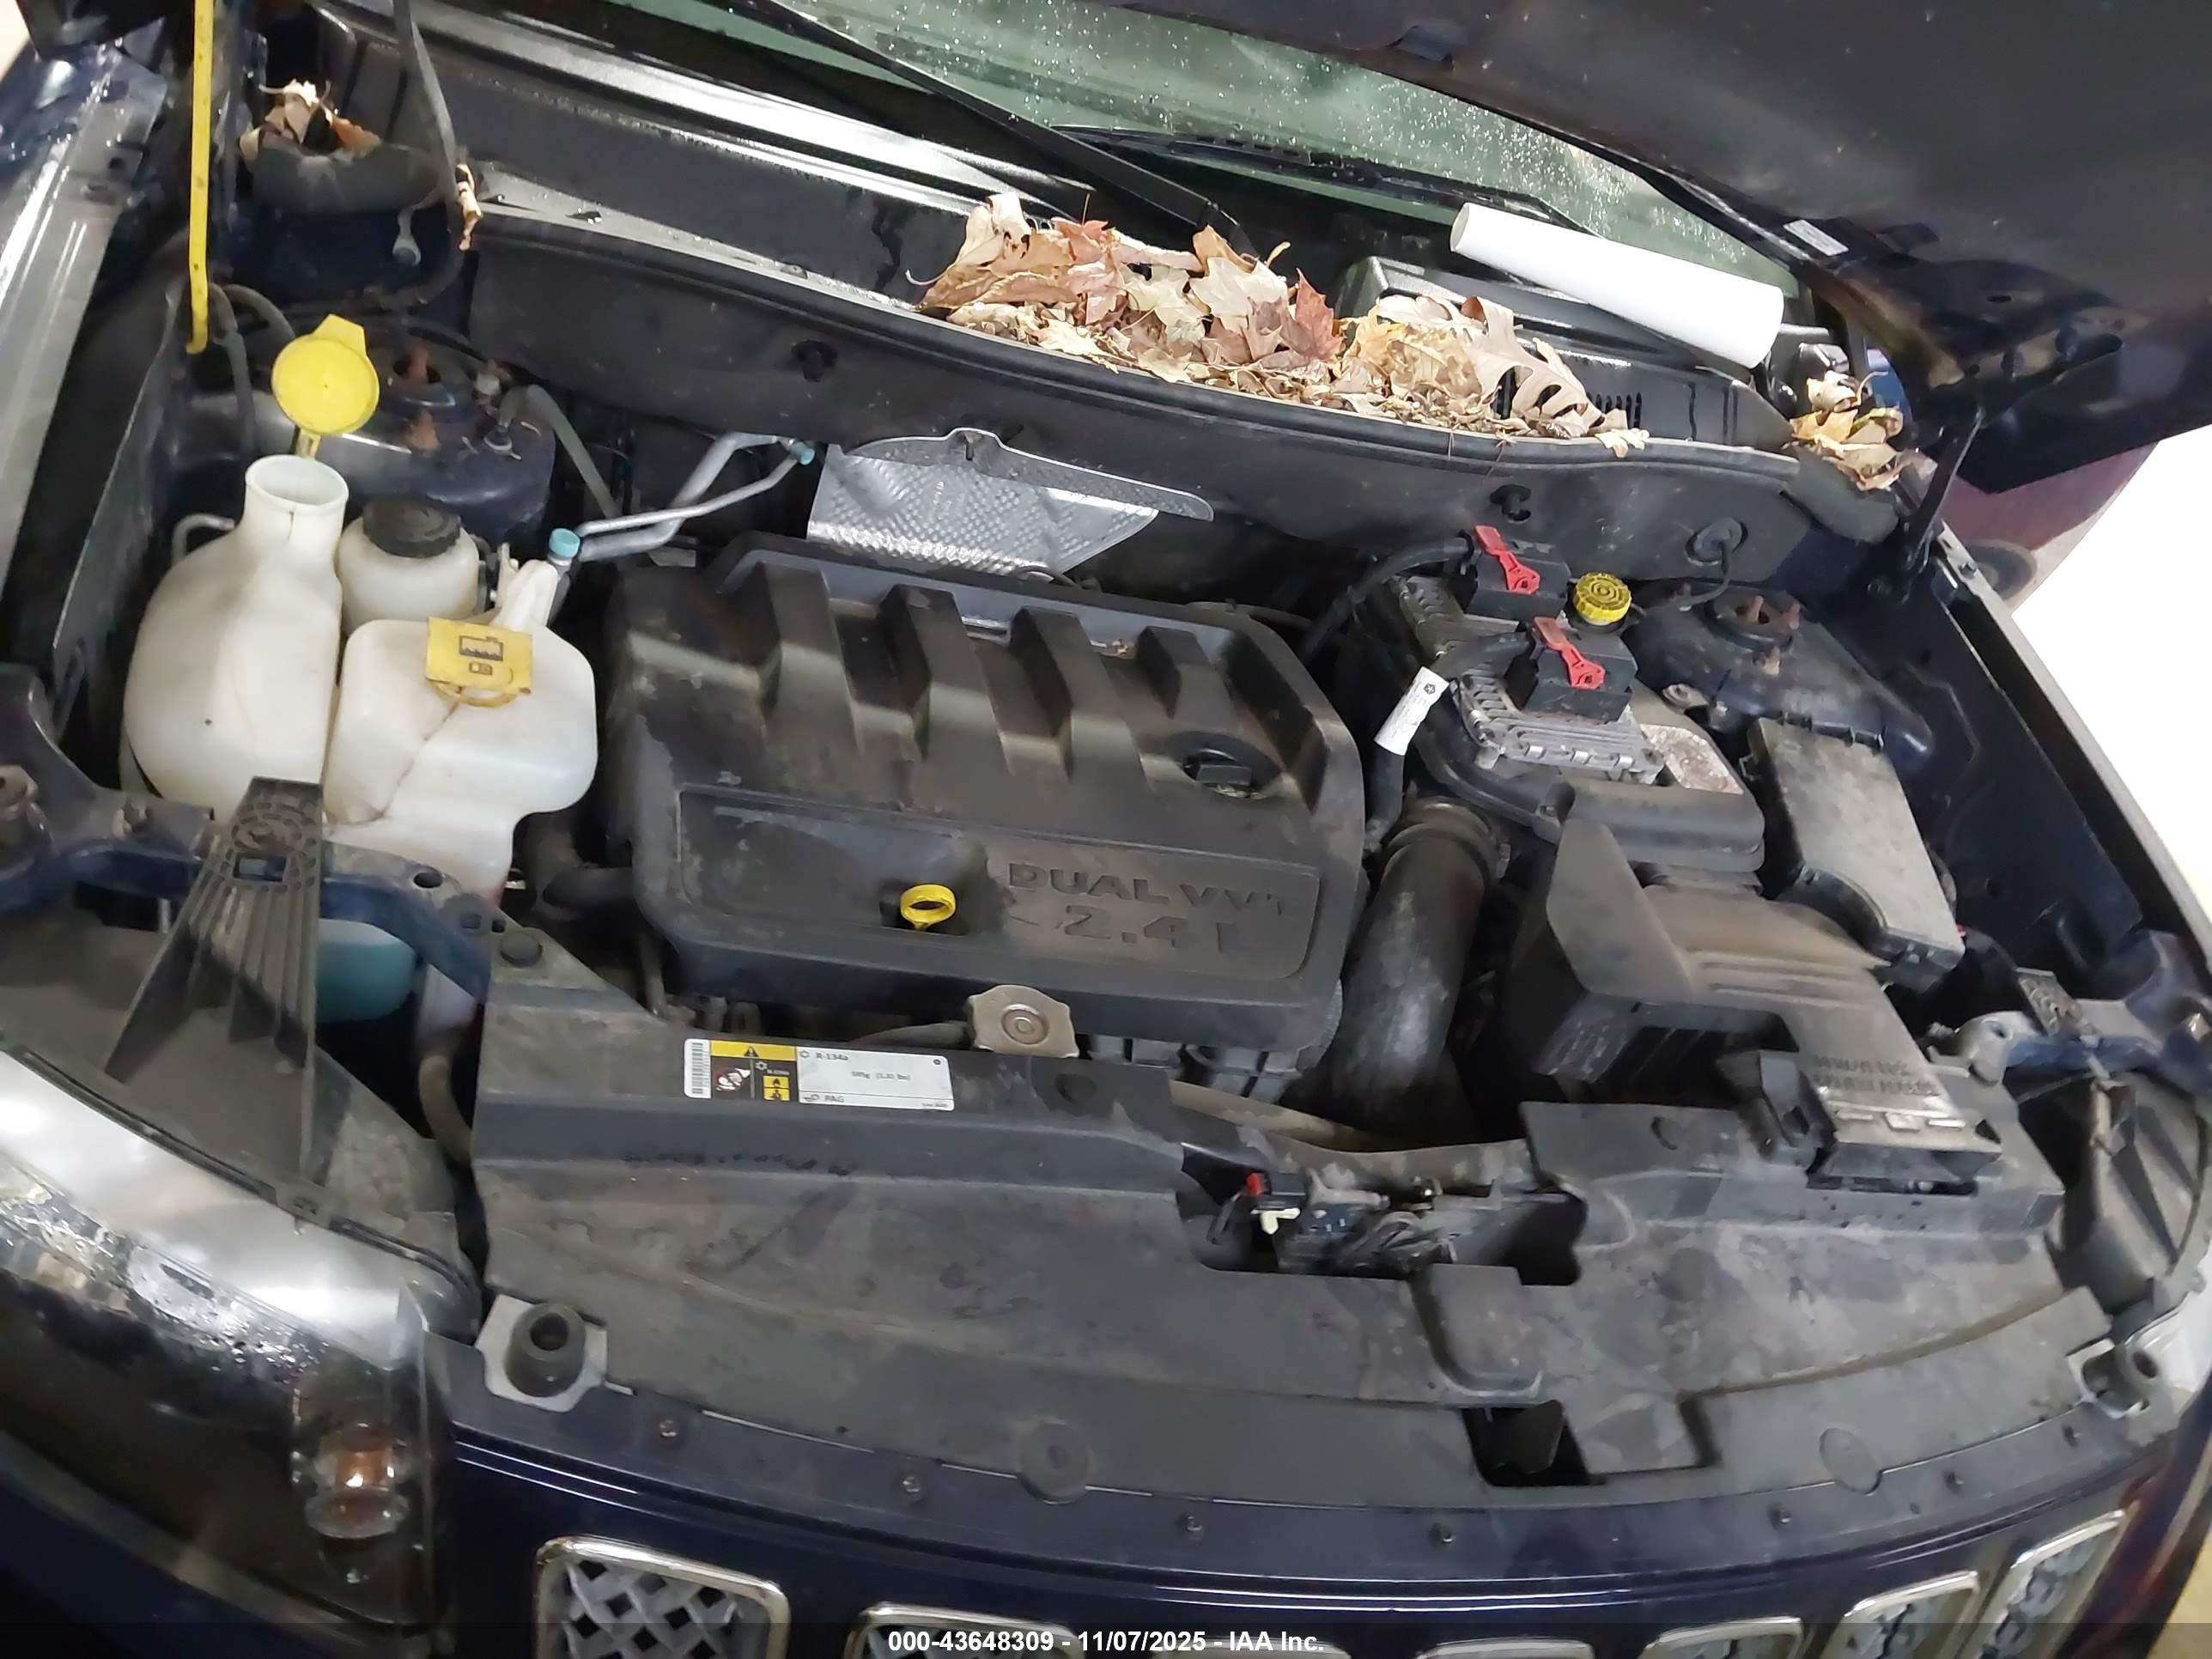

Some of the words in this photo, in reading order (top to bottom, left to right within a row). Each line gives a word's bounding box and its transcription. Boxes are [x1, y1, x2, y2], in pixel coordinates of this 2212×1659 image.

[1008, 862, 1170, 903] DUAL
[815, 1052, 849, 1062] R-134a
[824, 1095, 845, 1103] PAG
